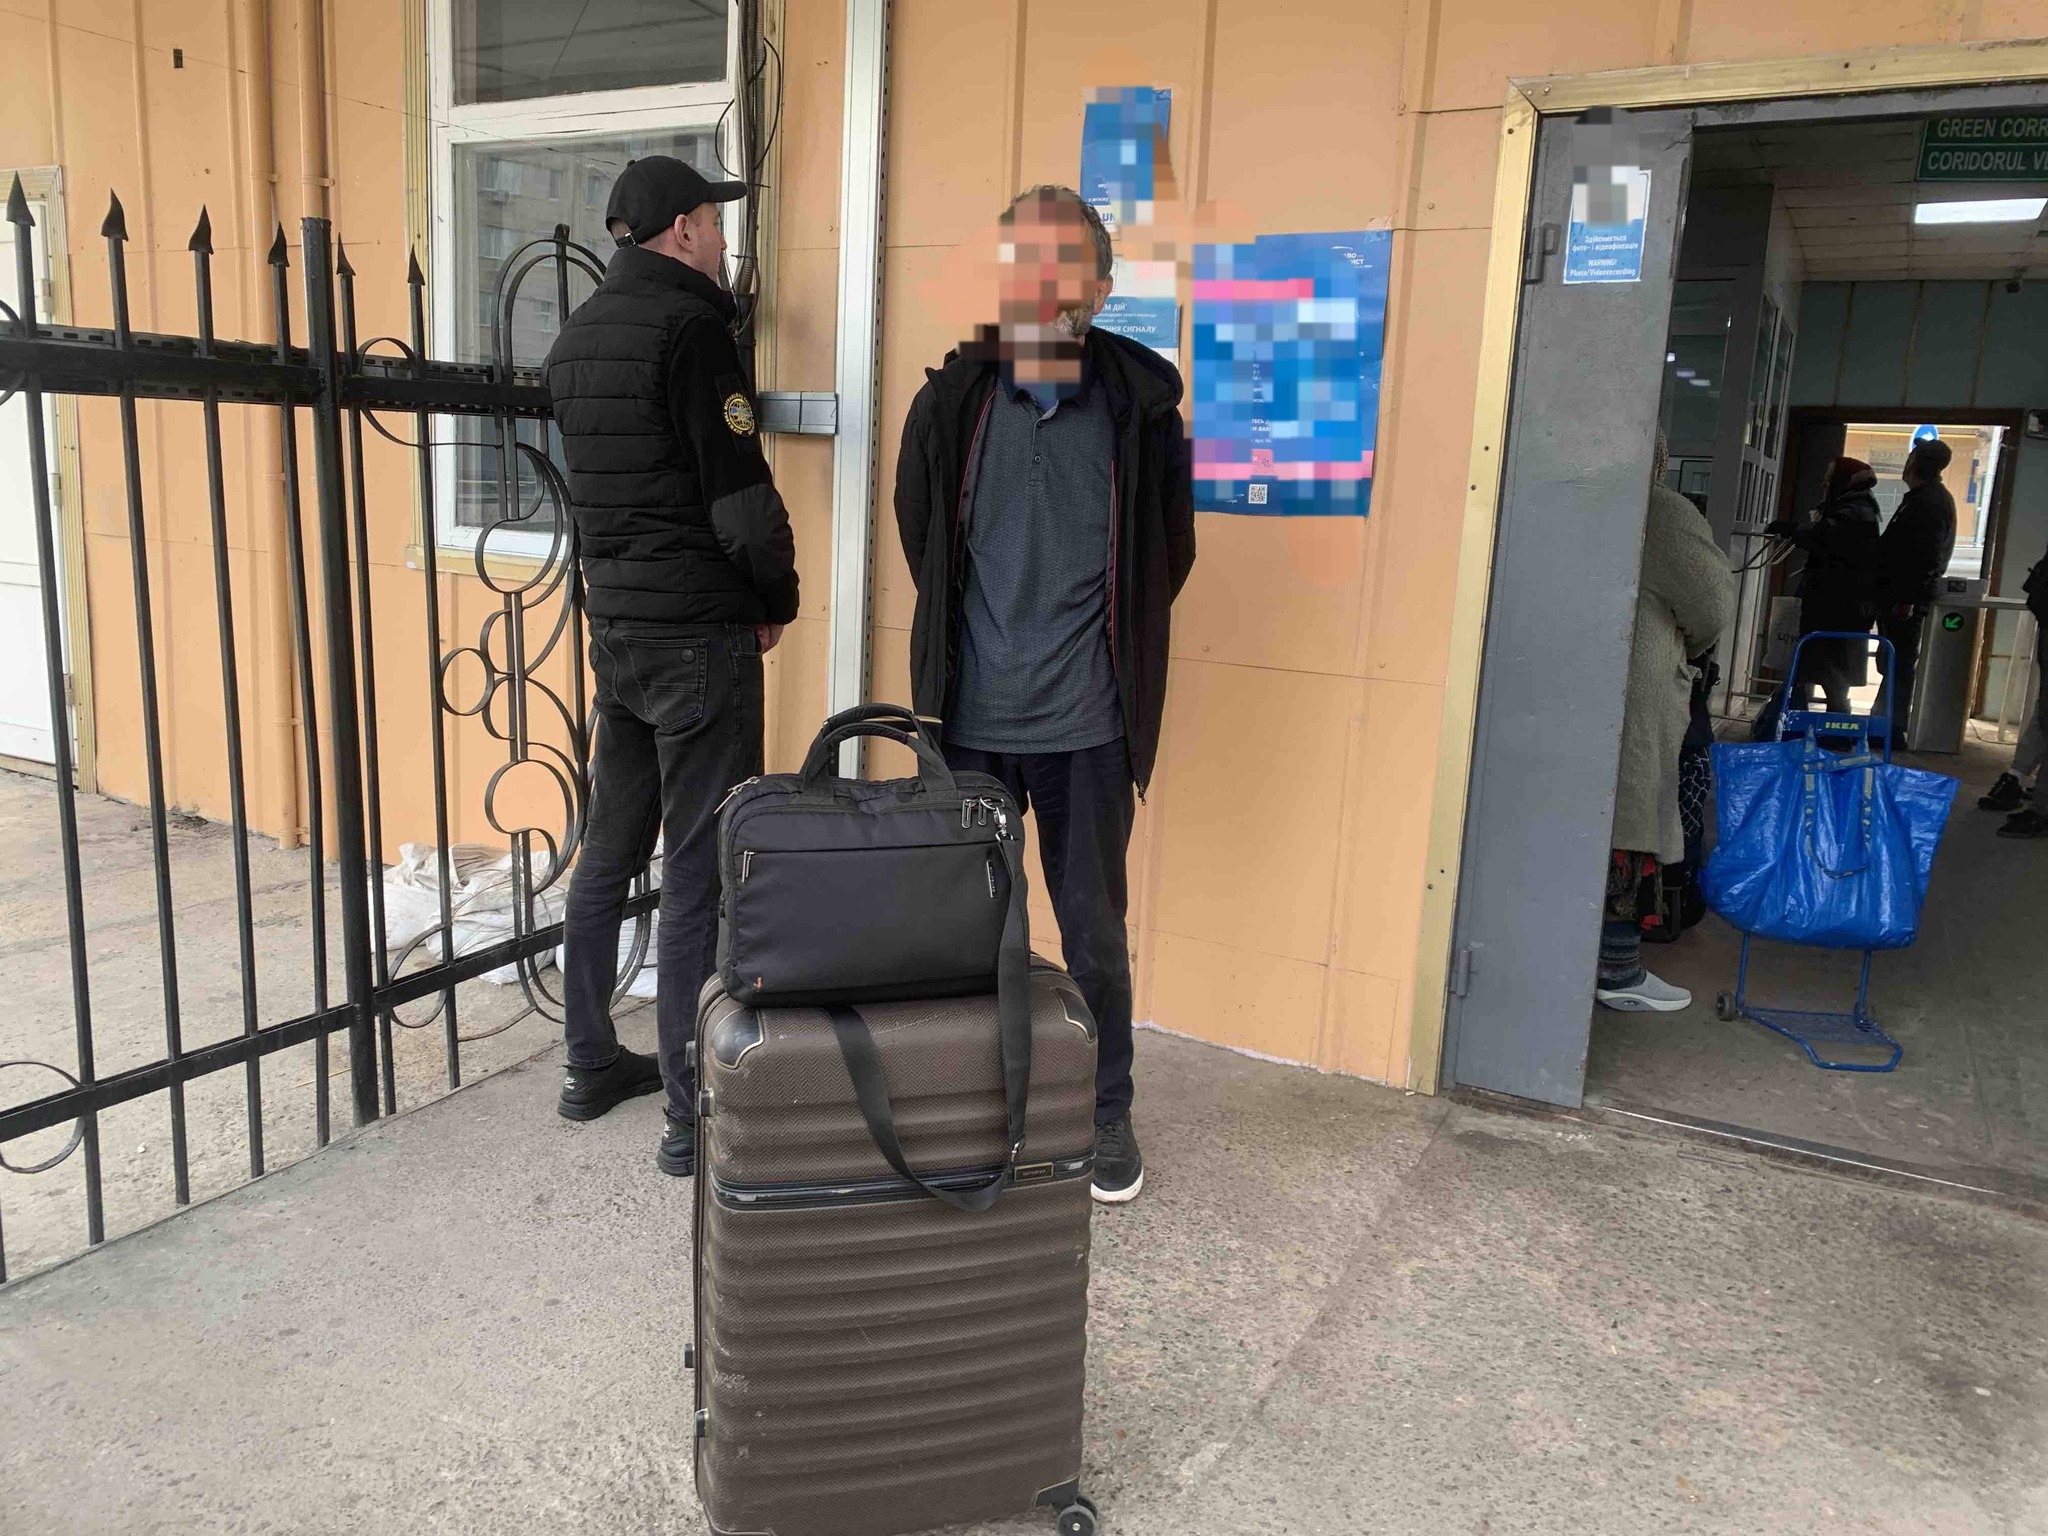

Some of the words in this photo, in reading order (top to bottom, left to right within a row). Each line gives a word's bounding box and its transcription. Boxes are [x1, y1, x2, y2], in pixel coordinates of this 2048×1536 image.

[1937, 117, 1996, 138] GREEN
[1928, 151, 2026, 171] CORIDORUL
[1122, 325, 1157, 333] СИГНАЛУ
[1825, 721, 1859, 730] IKEA
